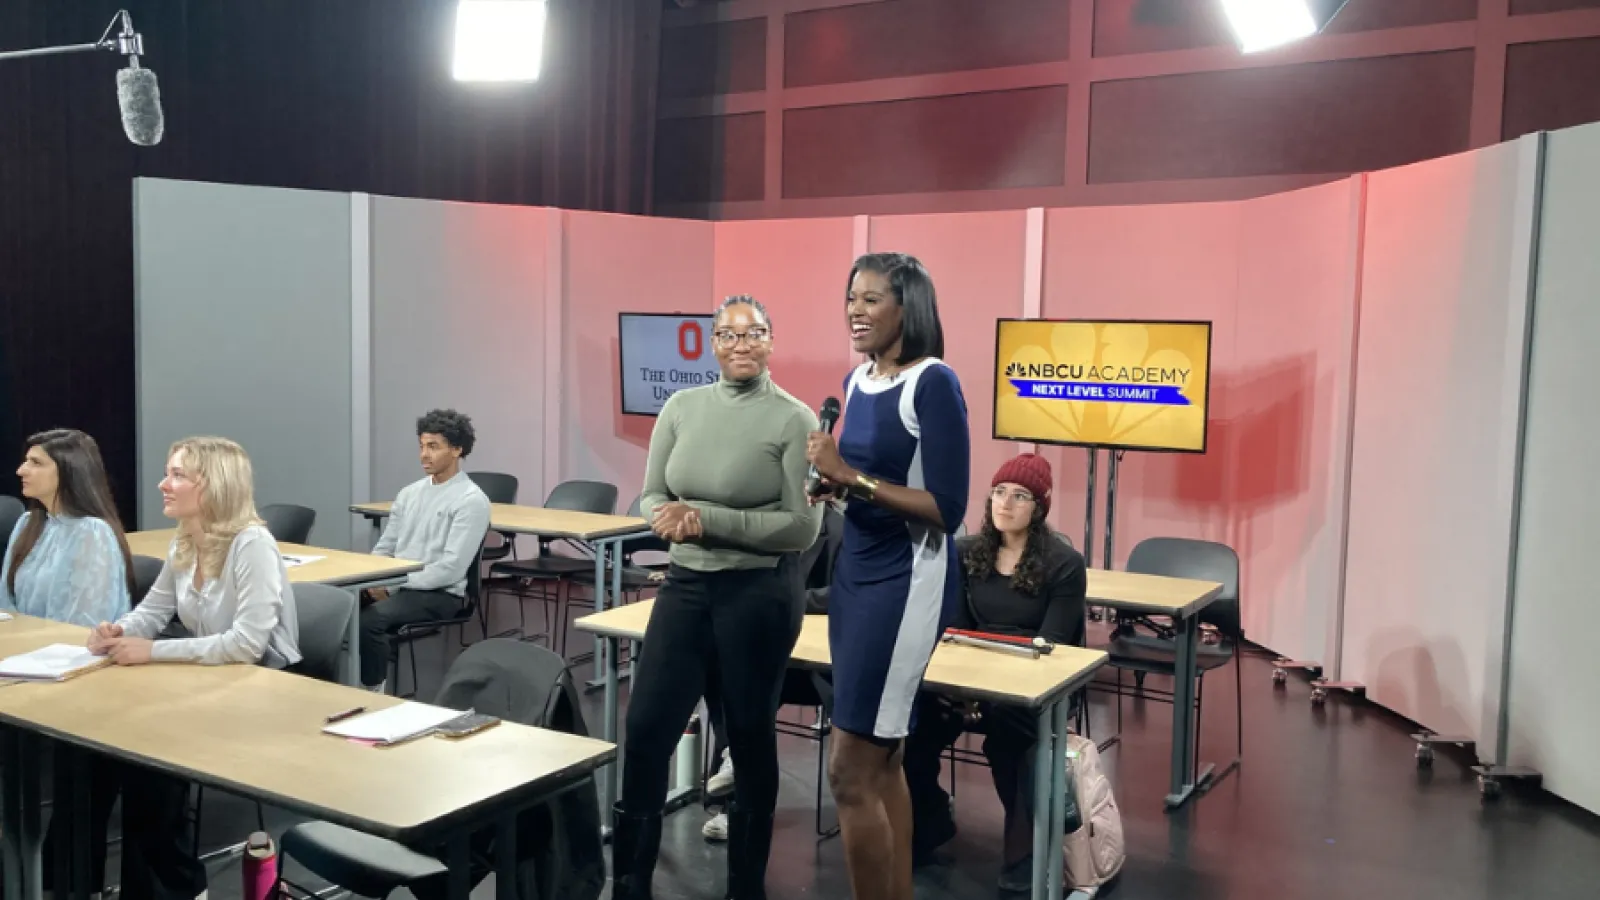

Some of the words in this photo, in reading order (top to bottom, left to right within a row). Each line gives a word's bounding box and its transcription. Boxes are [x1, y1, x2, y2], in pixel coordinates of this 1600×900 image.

[678, 320, 703, 360] O
[1028, 363, 1083, 379] NBCU
[1088, 366, 1190, 384] ACADEMY
[1032, 384, 1065, 396] NEXT
[1067, 385, 1105, 398] LEVEL
[1107, 387, 1159, 400] SUMMIT
